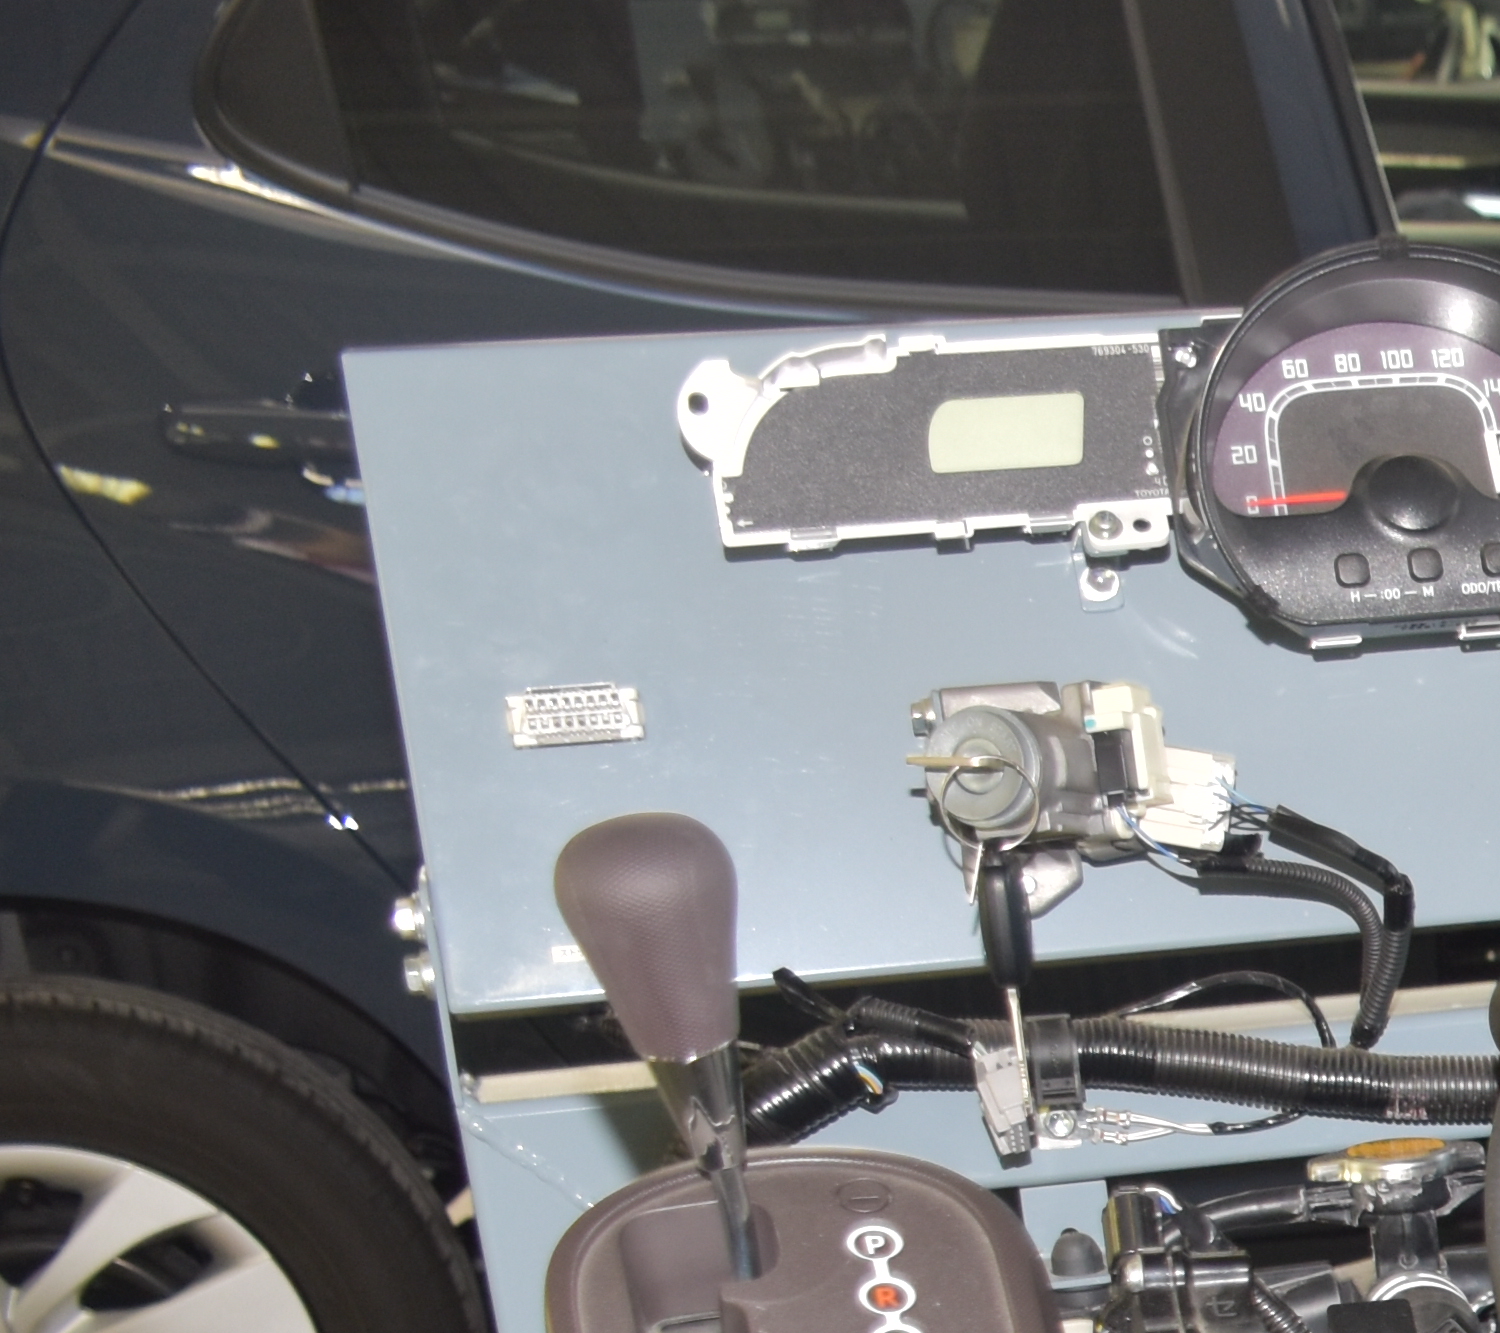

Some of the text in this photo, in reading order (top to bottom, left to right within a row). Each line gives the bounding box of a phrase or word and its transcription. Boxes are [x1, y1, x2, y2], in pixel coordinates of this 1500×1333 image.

[1281, 358, 1308, 379] 60
[1334, 352, 1361, 374] 80
[1380, 348, 1414, 370] 100
[1431, 347, 1464, 369] 120
[1238, 393, 1266, 413] 40
[1231, 445, 1258, 464] 20
[1349, 586, 1435, 602] H :00 M
[864, 1234, 885, 1256] P
[875, 1286, 896, 1308] R
